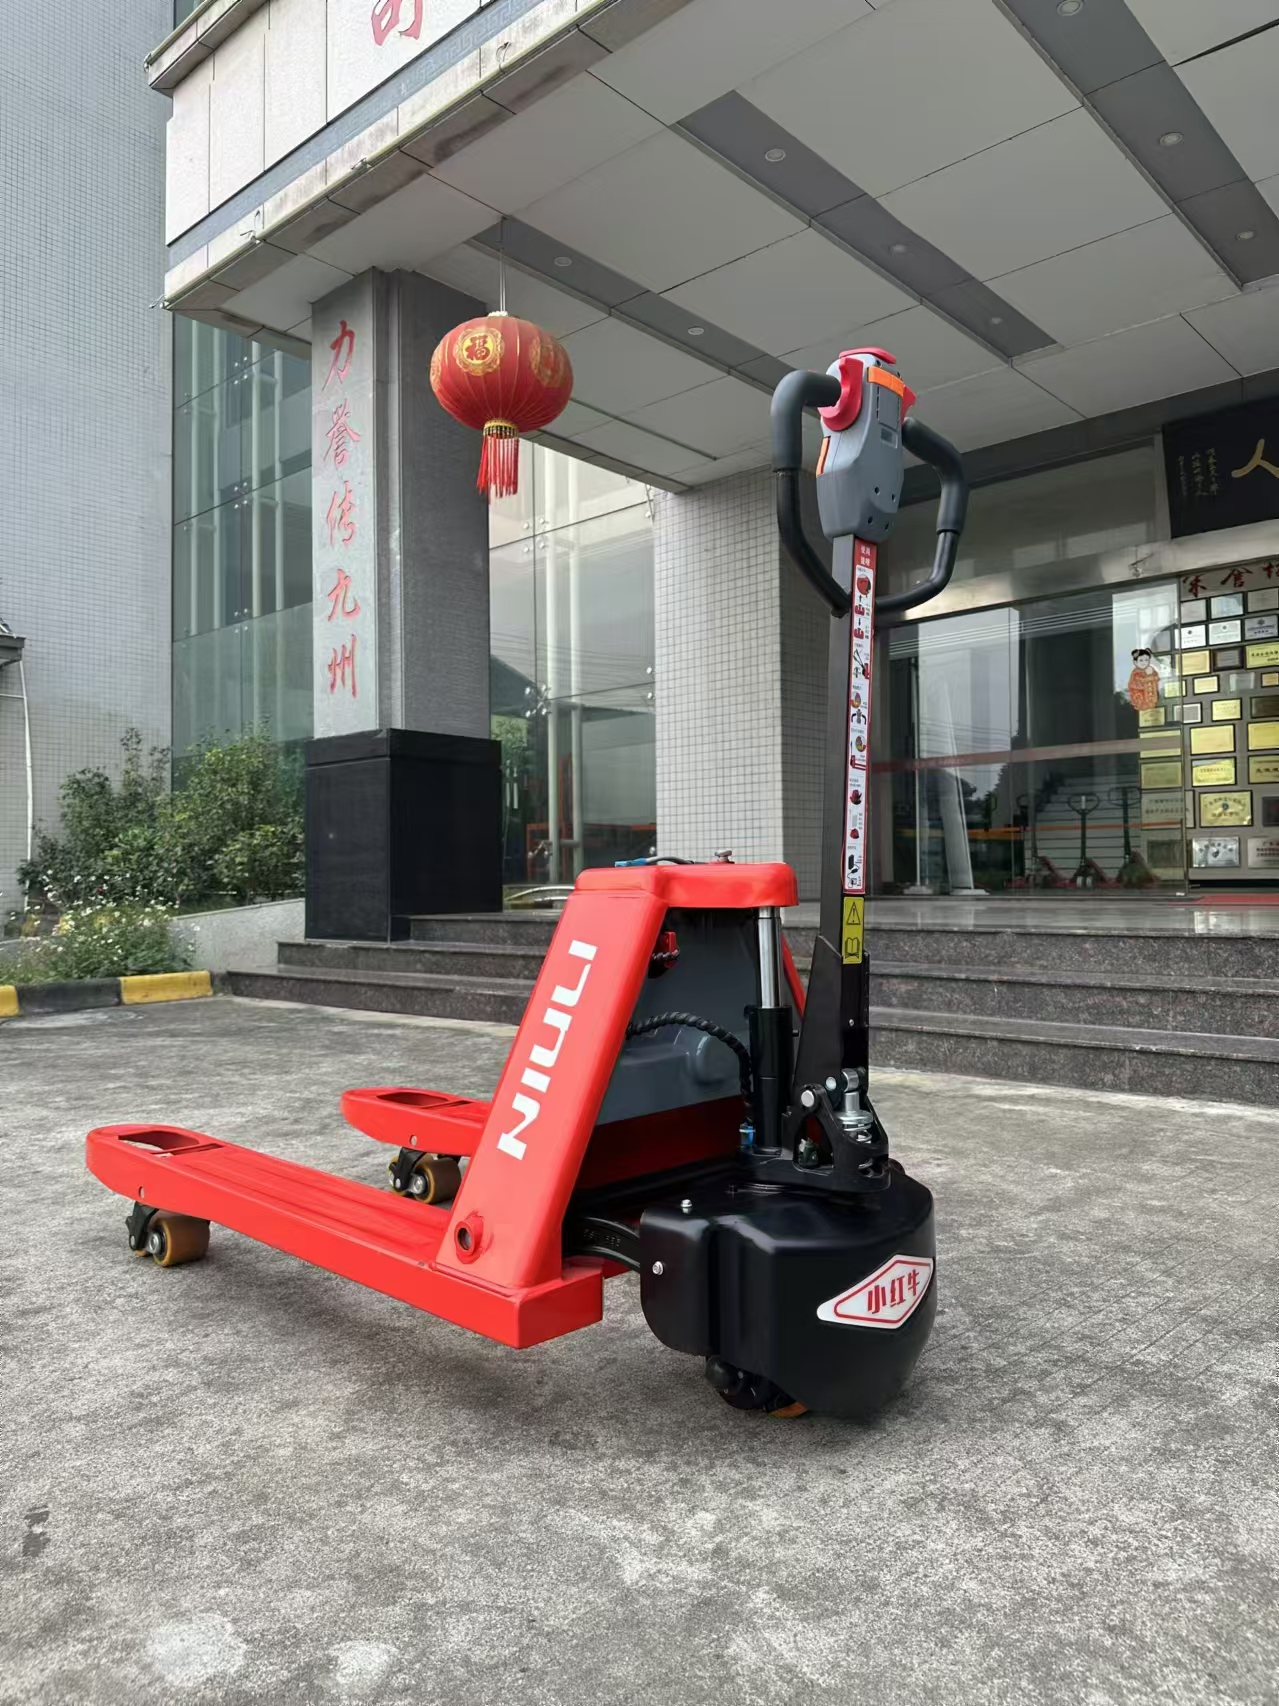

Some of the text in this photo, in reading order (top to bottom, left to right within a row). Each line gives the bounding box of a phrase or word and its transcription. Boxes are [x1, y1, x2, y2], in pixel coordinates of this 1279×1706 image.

[464, 336, 491, 360] 福
[496, 939, 599, 1161] NIULI
[867, 1268, 920, 1315] 小红牛
